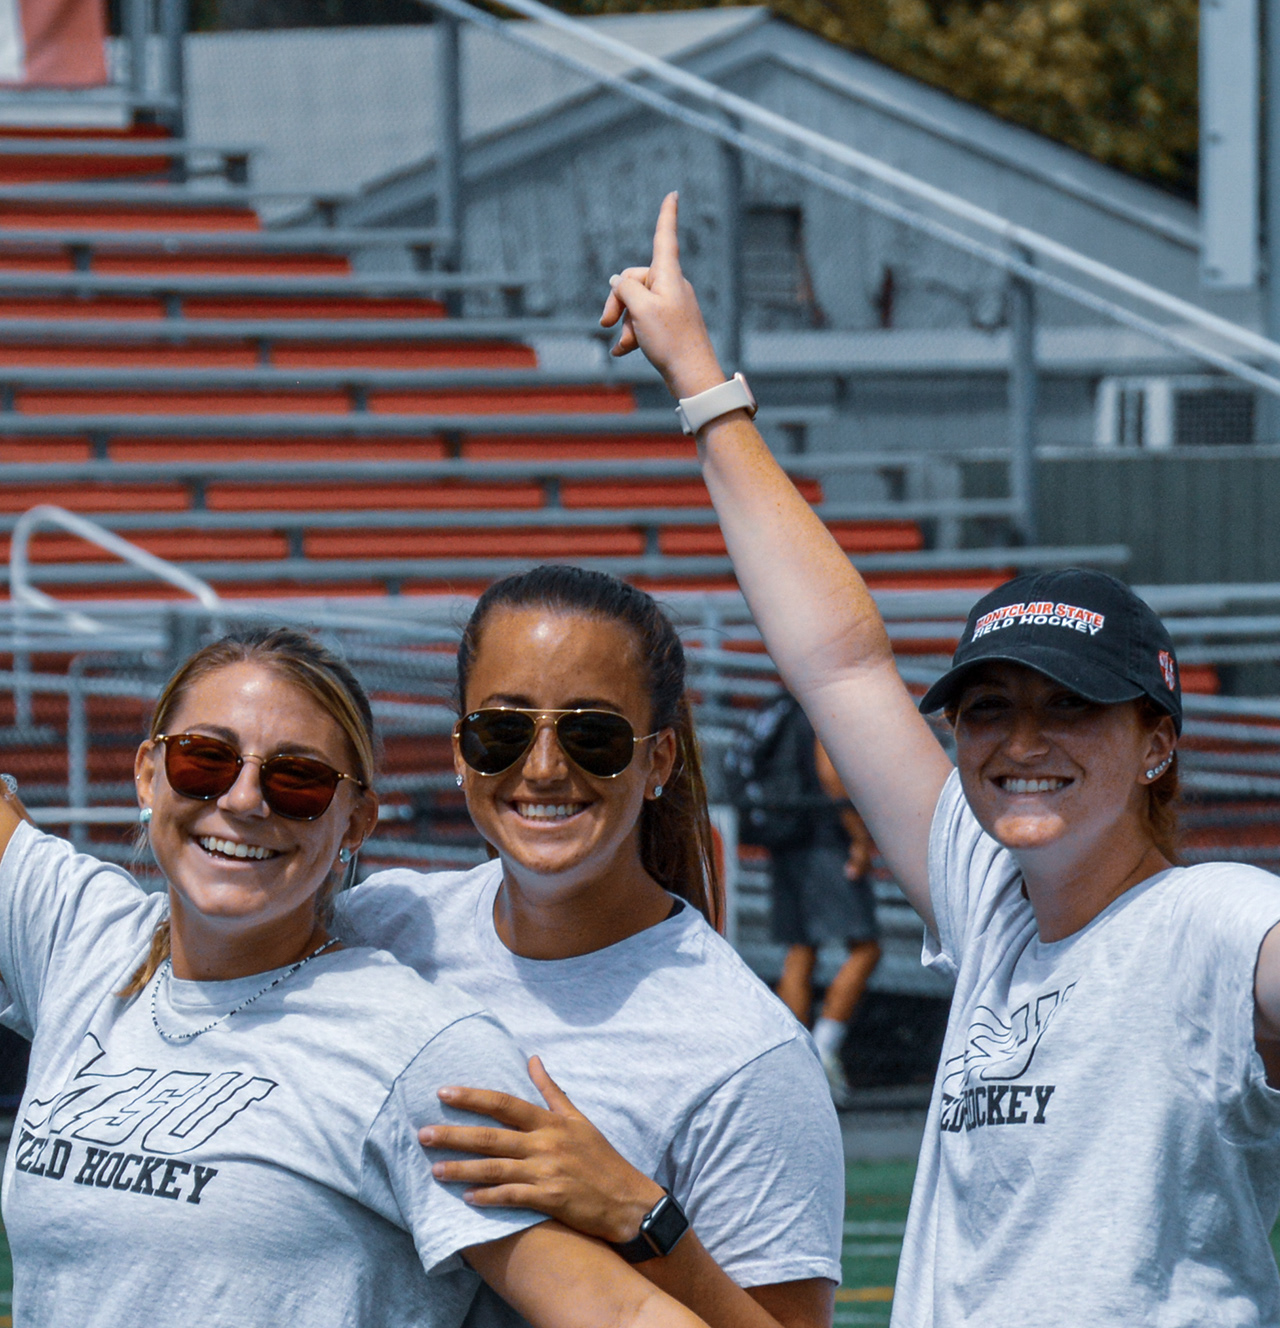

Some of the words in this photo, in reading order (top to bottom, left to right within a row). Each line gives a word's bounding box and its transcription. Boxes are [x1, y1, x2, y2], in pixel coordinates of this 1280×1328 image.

[970, 617, 1015, 642] FIELD
[1018, 615, 1100, 636] HOCKEY
[1055, 603, 1105, 629] STATE
[73, 1145, 218, 1204] HOCKEY
